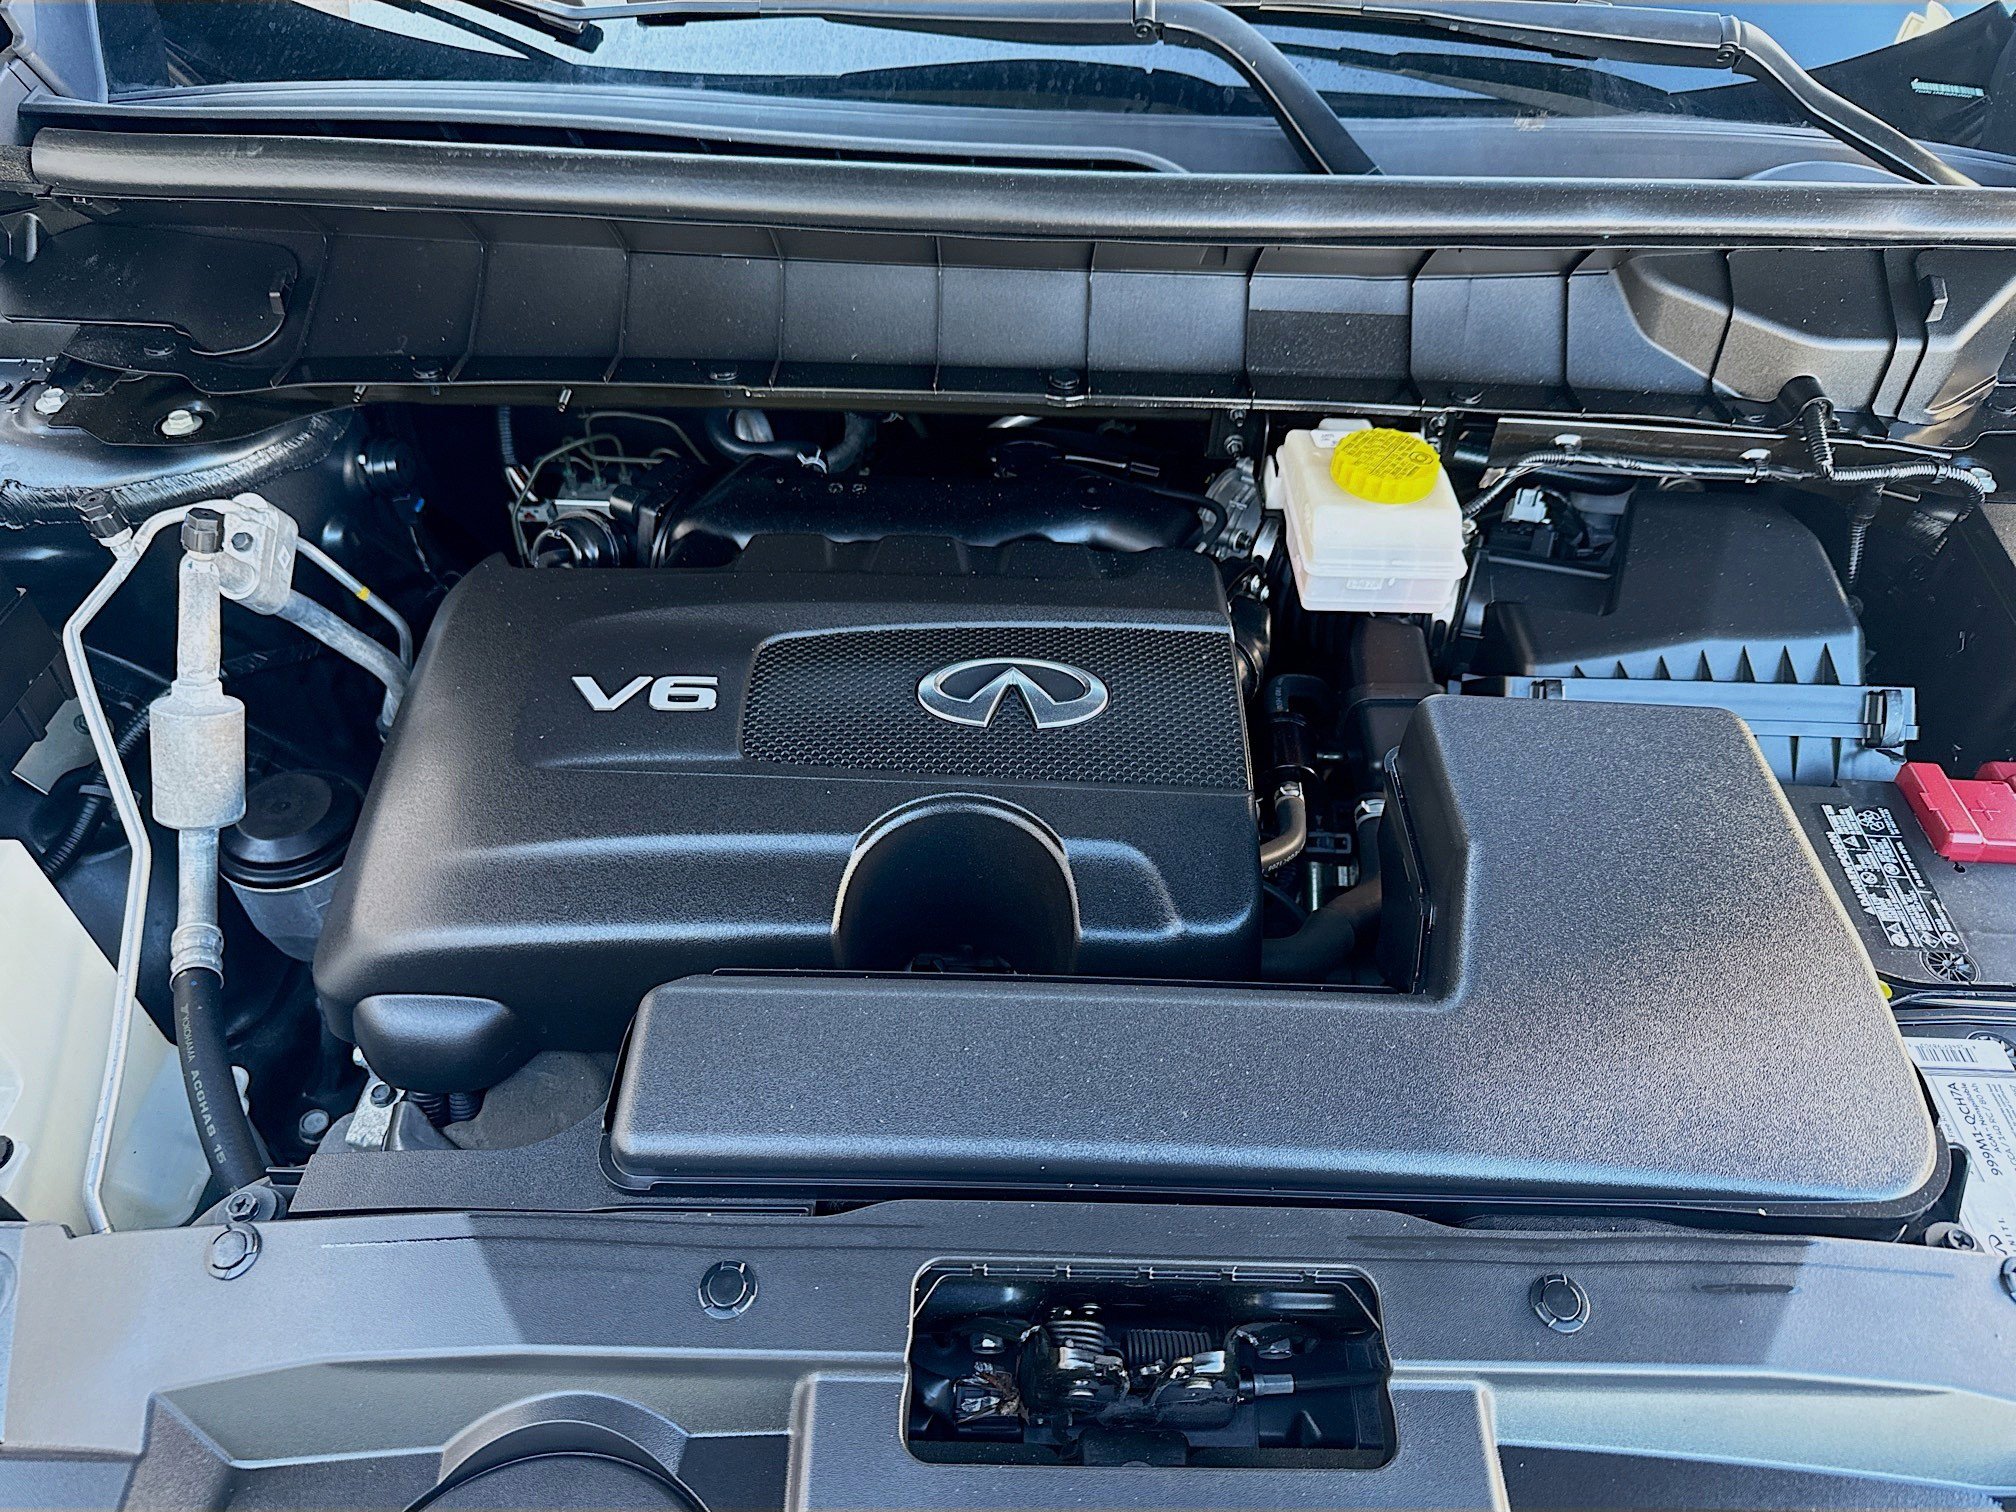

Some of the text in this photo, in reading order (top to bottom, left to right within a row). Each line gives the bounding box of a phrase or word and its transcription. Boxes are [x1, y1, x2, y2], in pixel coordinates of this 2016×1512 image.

[571, 676, 718, 711] V6
[181, 1015, 196, 1063] YOKOHAMA
[213, 1143, 227, 1164] 15
[1947, 1082, 2003, 1176] 999M1-QCH7A
